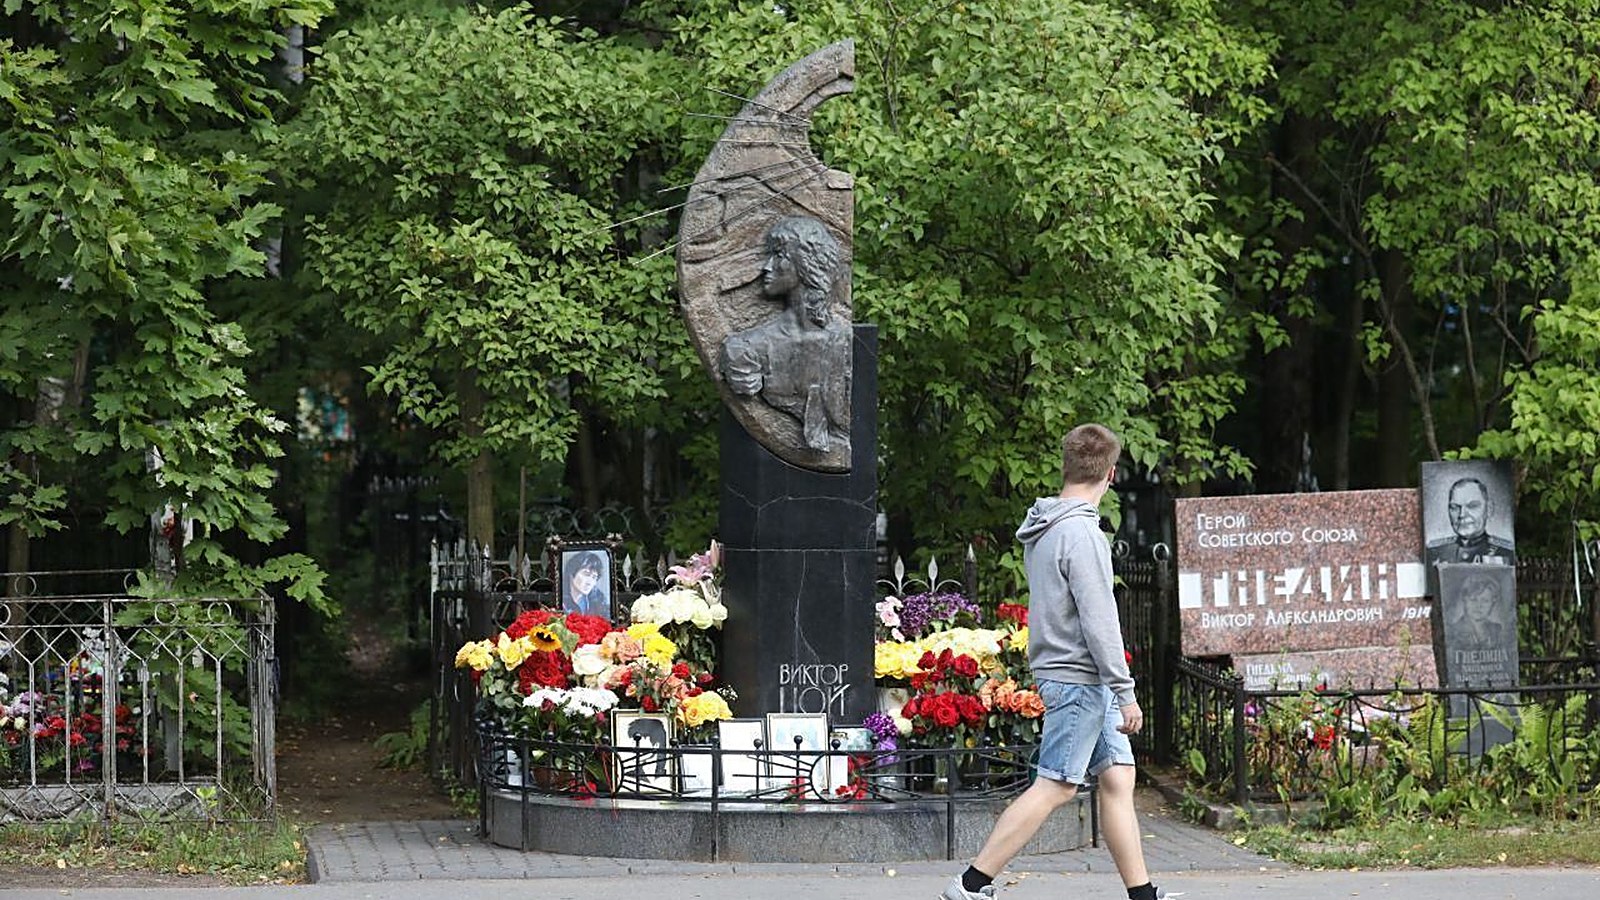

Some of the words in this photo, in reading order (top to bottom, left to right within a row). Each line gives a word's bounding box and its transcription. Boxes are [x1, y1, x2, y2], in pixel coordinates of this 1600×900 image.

[1197, 513, 1246, 531] ГЕРОЙ
[1198, 531, 1293, 548] СОВЕТСКОГО
[1302, 526, 1358, 543] СОЮЗА
[1201, 611, 1255, 629] ВИКТОР
[1265, 607, 1383, 626] АЛЕКСАНДРОВИЧ
[779, 663, 849, 687] ВИКТОР
